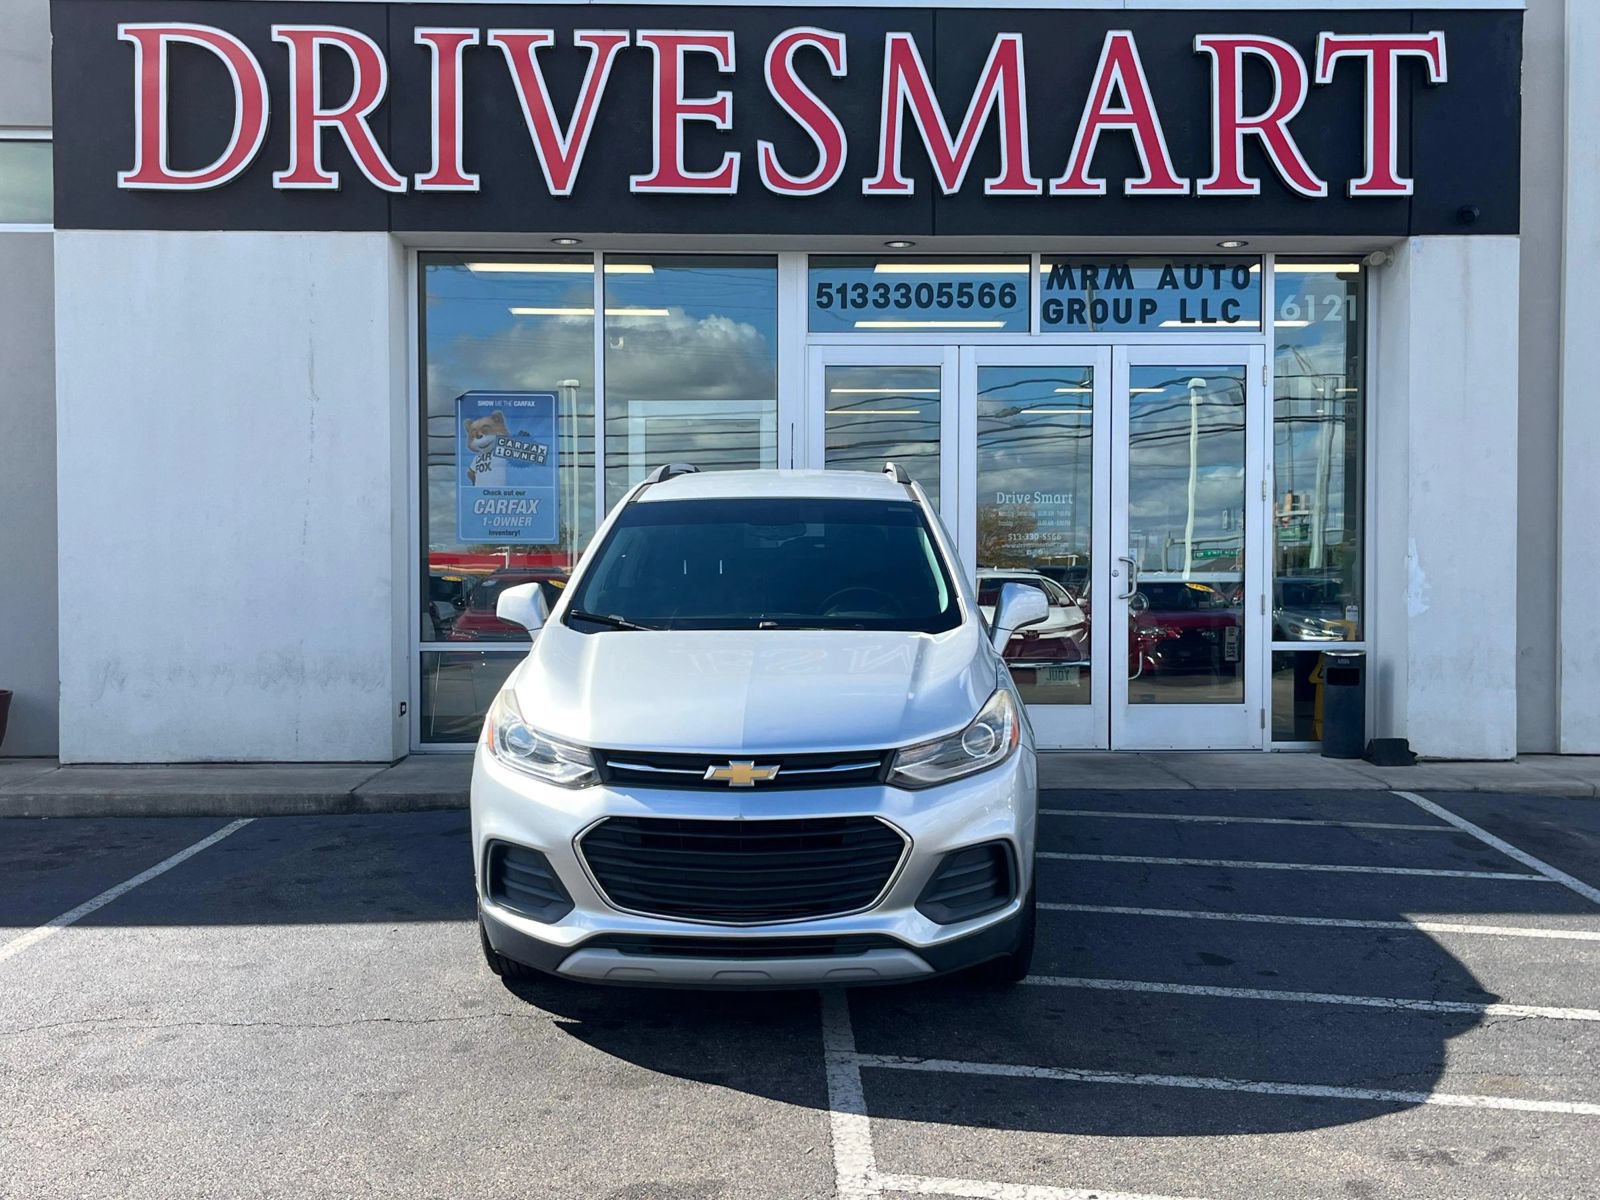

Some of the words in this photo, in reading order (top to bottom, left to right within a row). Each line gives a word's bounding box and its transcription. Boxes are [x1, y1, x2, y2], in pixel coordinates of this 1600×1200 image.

[116, 22, 1449, 199] DRIVESMART
[1046, 264, 1135, 290] MRM
[1157, 264, 1250, 290] AUTO
[815, 281, 1018, 310] 5133305566
[1042, 298, 1158, 325] GROUP
[1180, 298, 1241, 324] LLC
[1280, 294, 1357, 322] 6121
[498, 438, 547, 456] CARFAX
[475, 462, 492, 473] FOX
[996, 491, 1031, 504] Drive
[1033, 491, 1073, 504] Smart
[474, 499, 540, 515] CARFAX
[483, 516, 533, 527] 1-OWNER
[1008, 533, 1062, 541] 513-330-5566
